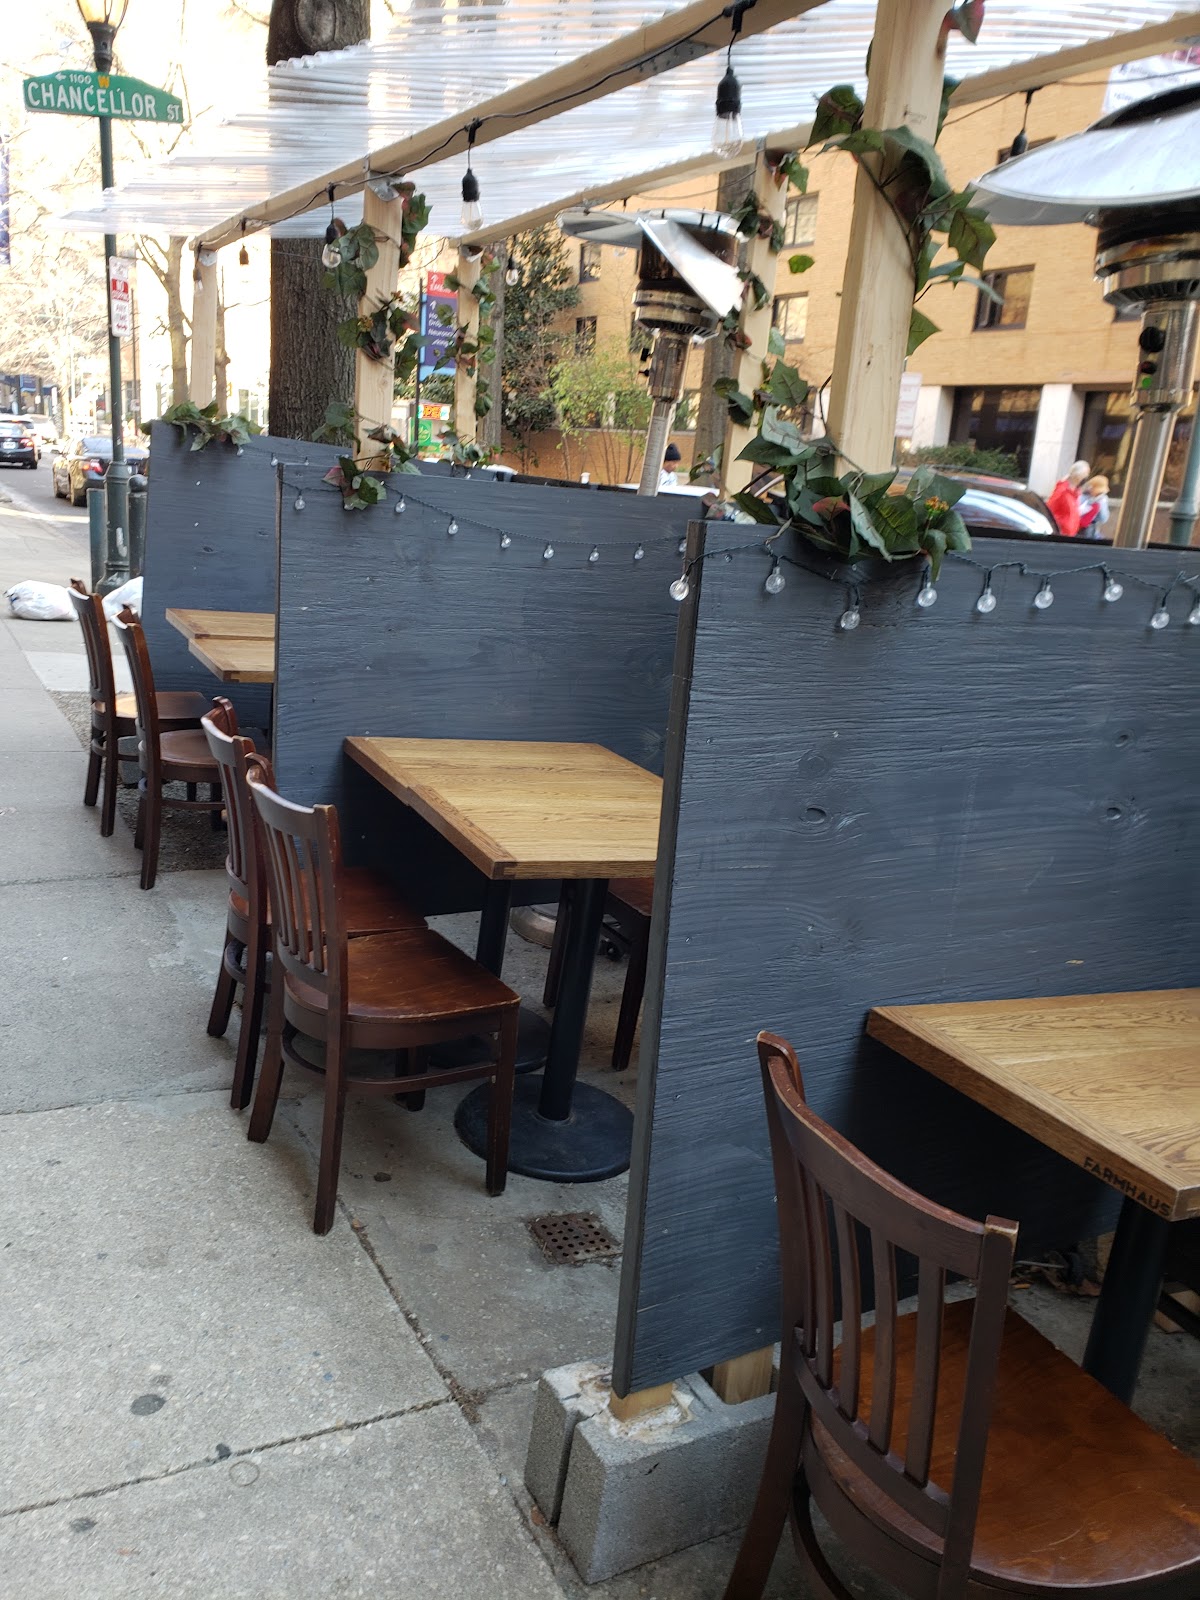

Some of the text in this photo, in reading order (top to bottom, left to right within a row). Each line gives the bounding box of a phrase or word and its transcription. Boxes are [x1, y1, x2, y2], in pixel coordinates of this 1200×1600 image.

[69, 74, 92, 84] 1100
[27, 81, 180, 121] CHANCELLOR ST
[1083, 1156, 1171, 1216] FARMHAUS
